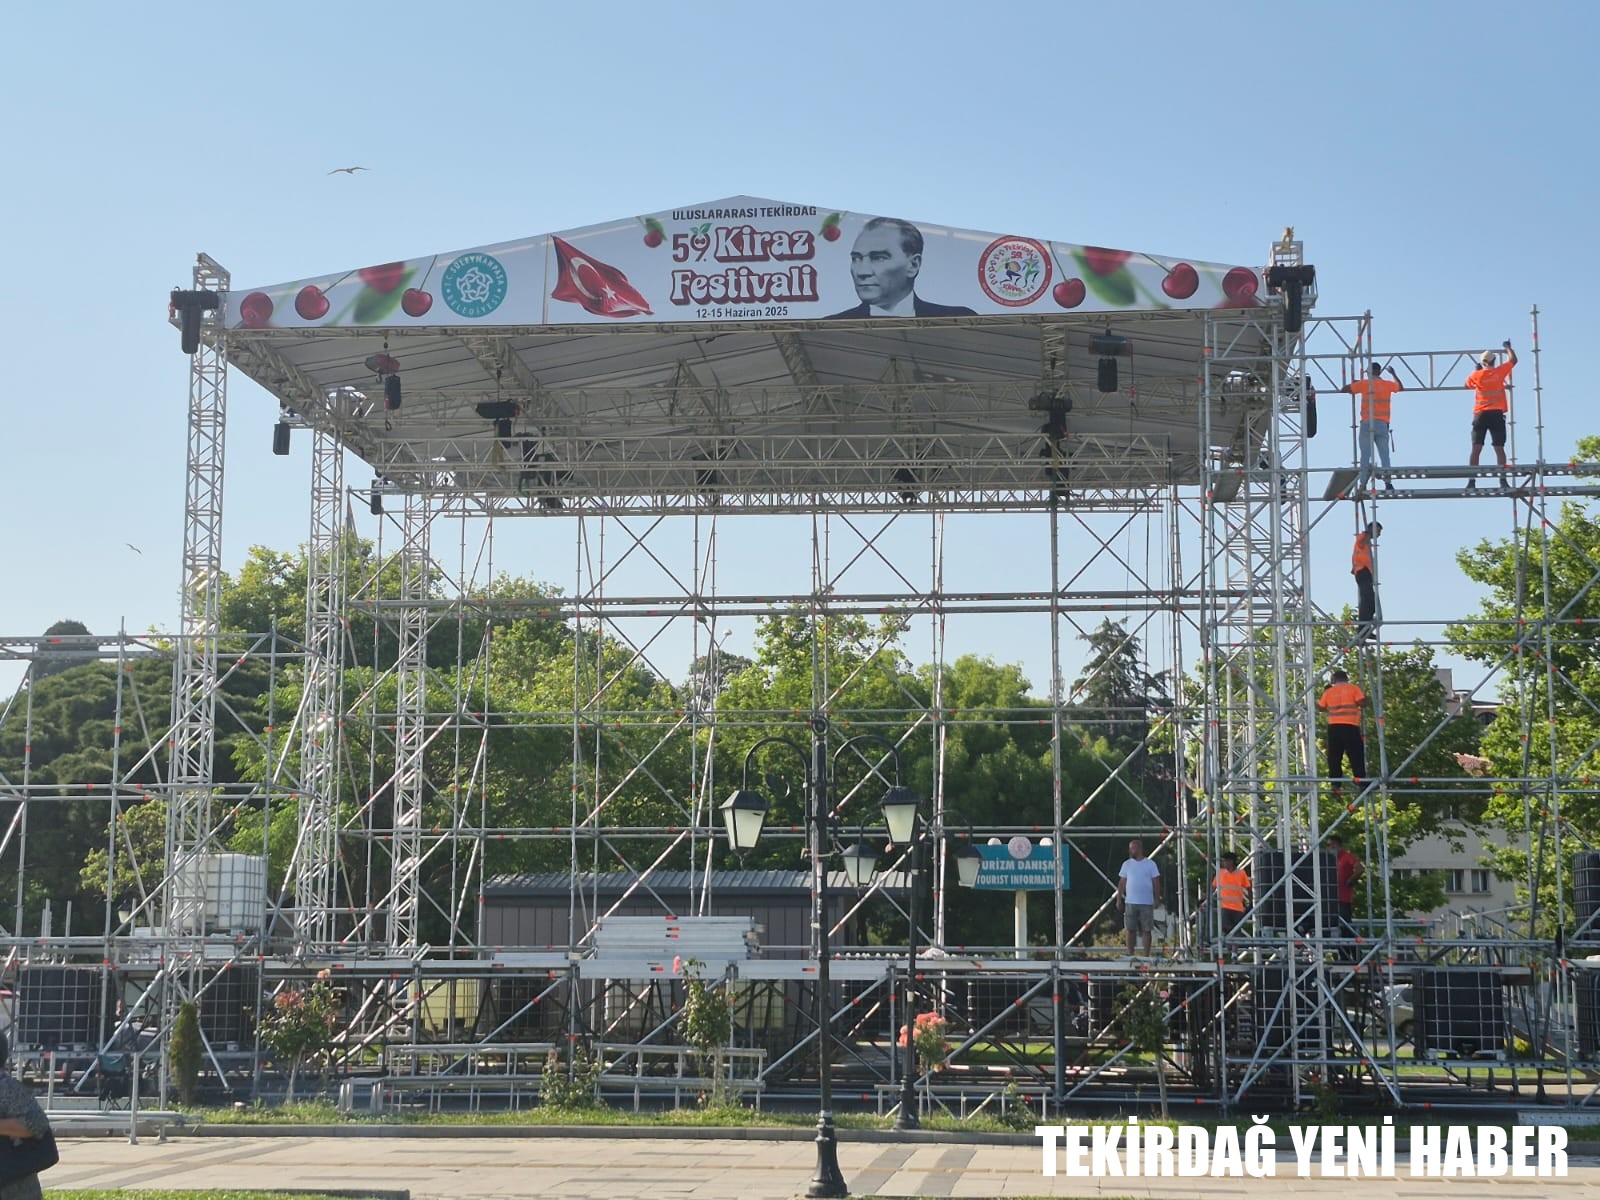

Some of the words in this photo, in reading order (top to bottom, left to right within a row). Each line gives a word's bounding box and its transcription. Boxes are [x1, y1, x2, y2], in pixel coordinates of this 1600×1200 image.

[672, 207, 758, 221] ULUSLARARASI
[714, 224, 815, 263] Kiraz
[669, 265, 819, 305] Festivali
[696, 307, 722, 319] 12-15
[725, 306, 762, 318] Haziran
[765, 306, 788, 317] 2025
[981, 857, 1015, 870] URİZM
[976, 874, 1009, 885] TOURIST
